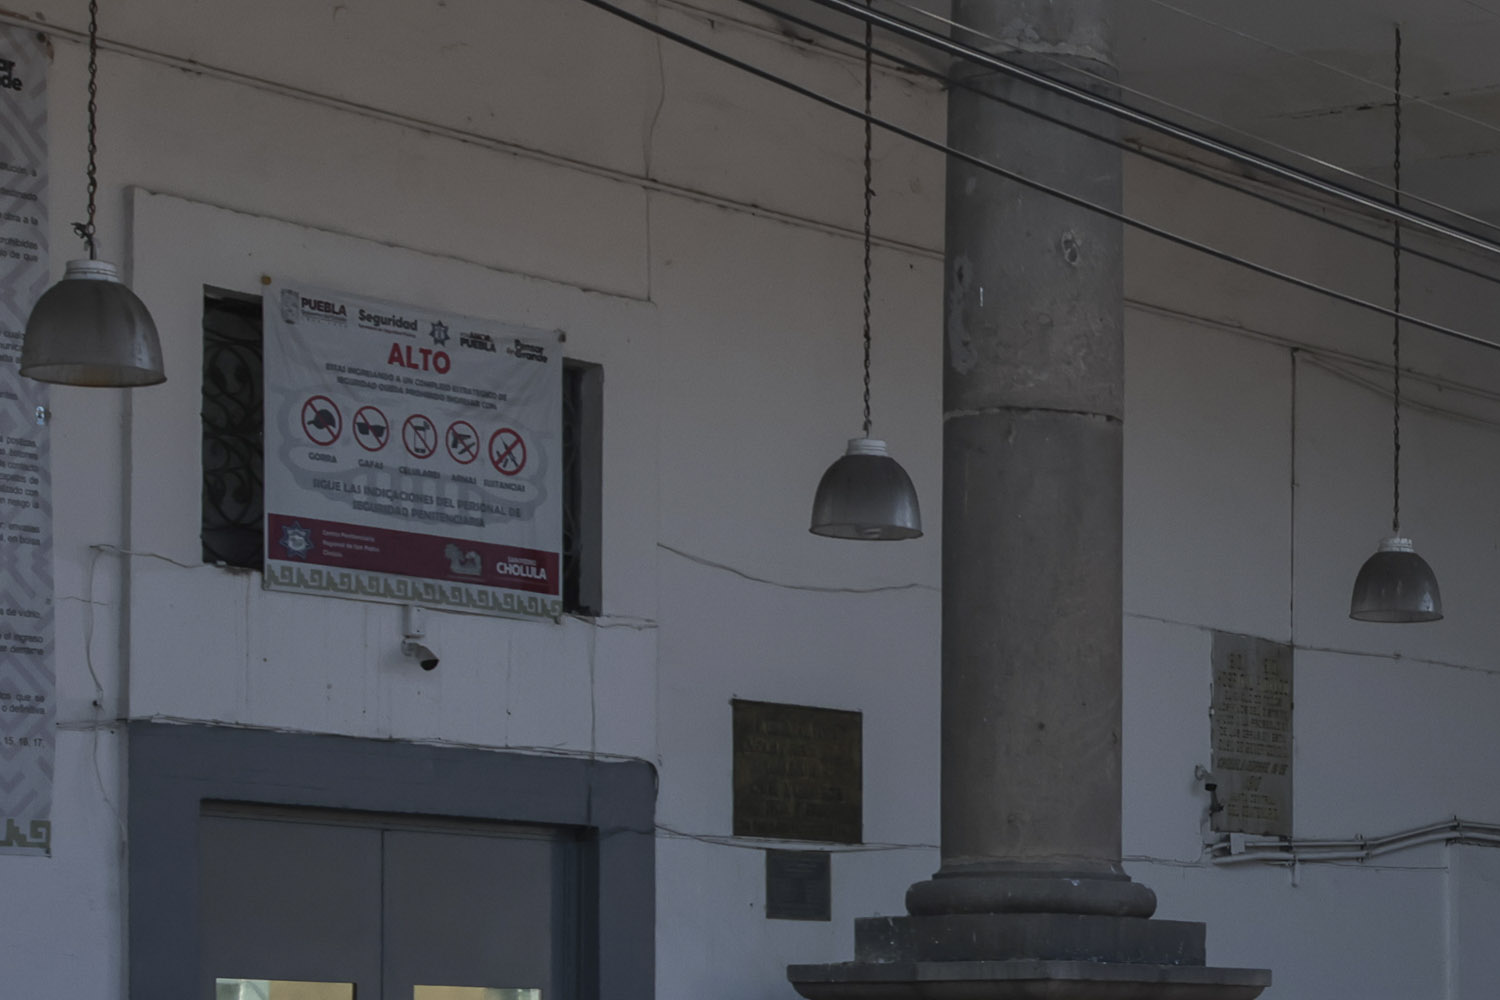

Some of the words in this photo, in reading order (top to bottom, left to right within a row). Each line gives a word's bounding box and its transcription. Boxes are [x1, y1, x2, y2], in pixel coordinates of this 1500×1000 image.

[300, 297, 347, 317] PUEBLA
[358, 309, 417, 332] Seguridad
[387, 342, 451, 375] ALTO
[308, 452, 338, 464] GORRA
[358, 458, 384, 470] GAFAS
[451, 474, 477, 485] ARMAS
[313, 478, 341, 491] SIGUE
[343, 482, 361, 494] LAS
[363, 485, 434, 505] INDICACIONES
[436, 496, 455, 509] DEL
[457, 499, 507, 516] PERSONAL
[508, 506, 521, 518] DE
[352, 499, 409, 517] SEGURIDAD
[411, 508, 485, 528] PENITENCIARIA
[496, 561, 548, 580] CHOLULA
